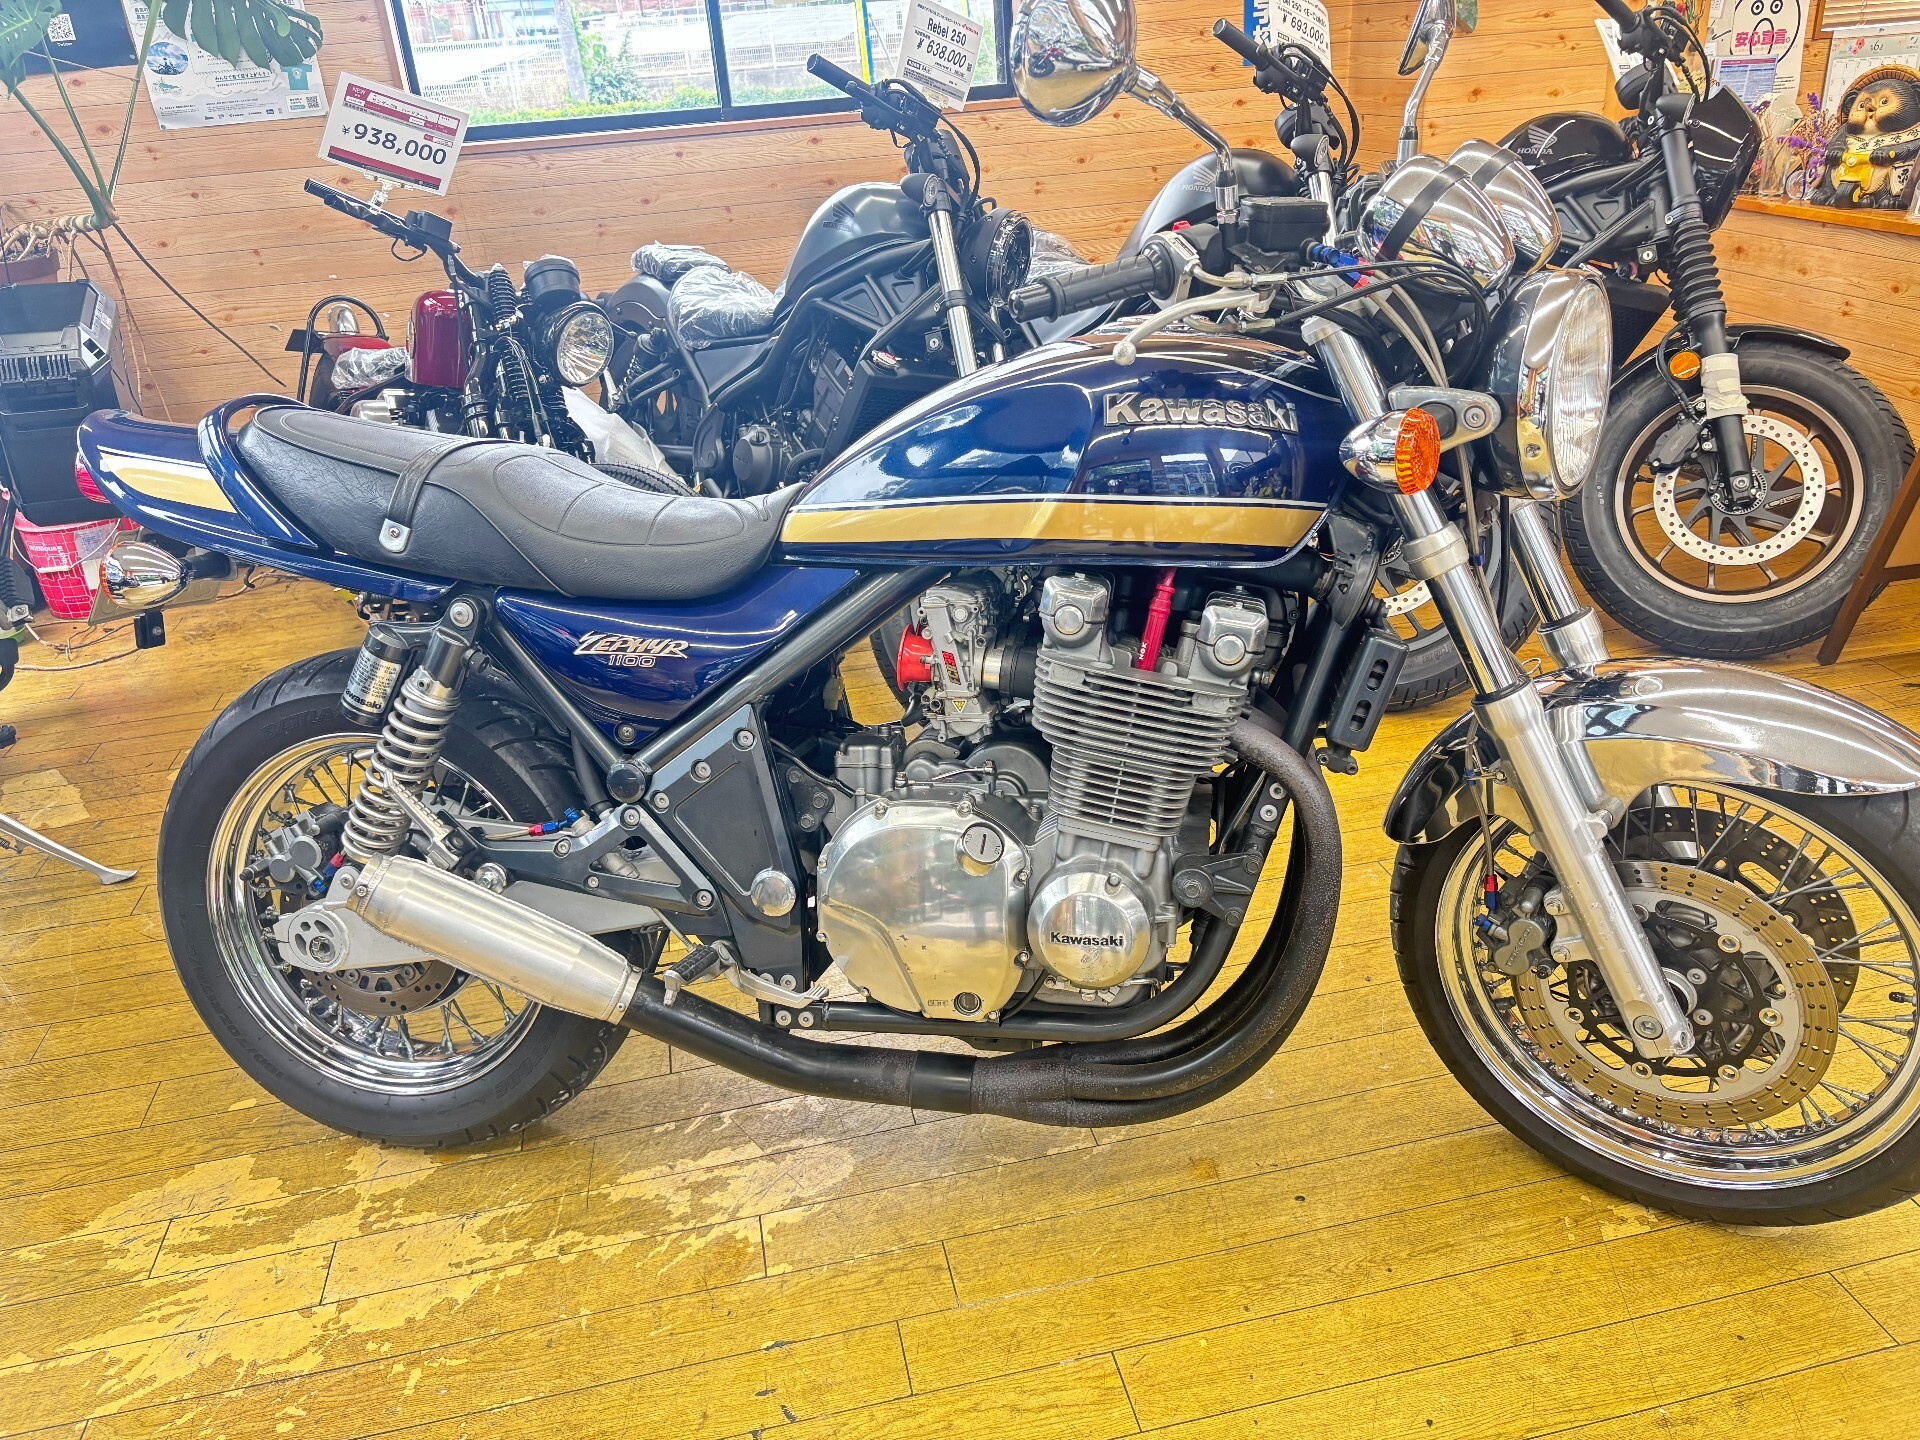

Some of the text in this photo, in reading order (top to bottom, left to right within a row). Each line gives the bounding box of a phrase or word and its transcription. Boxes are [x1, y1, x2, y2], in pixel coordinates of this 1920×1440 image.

[927, 17, 950, 39] Rebel
[950, 28, 967, 46] 250
[926, 39, 967, 68] 638,000
[1516, 147, 1554, 155] HONDA
[1180, 184, 1212, 193] HONDA
[1103, 391, 1299, 435] Kawasaki
[573, 630, 690, 660] ZEPHYR
[1138, 641, 1148, 661] NGK
[608, 654, 657, 668] 1100
[345, 688, 382, 710] awasaki
[1049, 931, 1125, 948] Kawasaki
[1506, 928, 1532, 967] TOKICO
